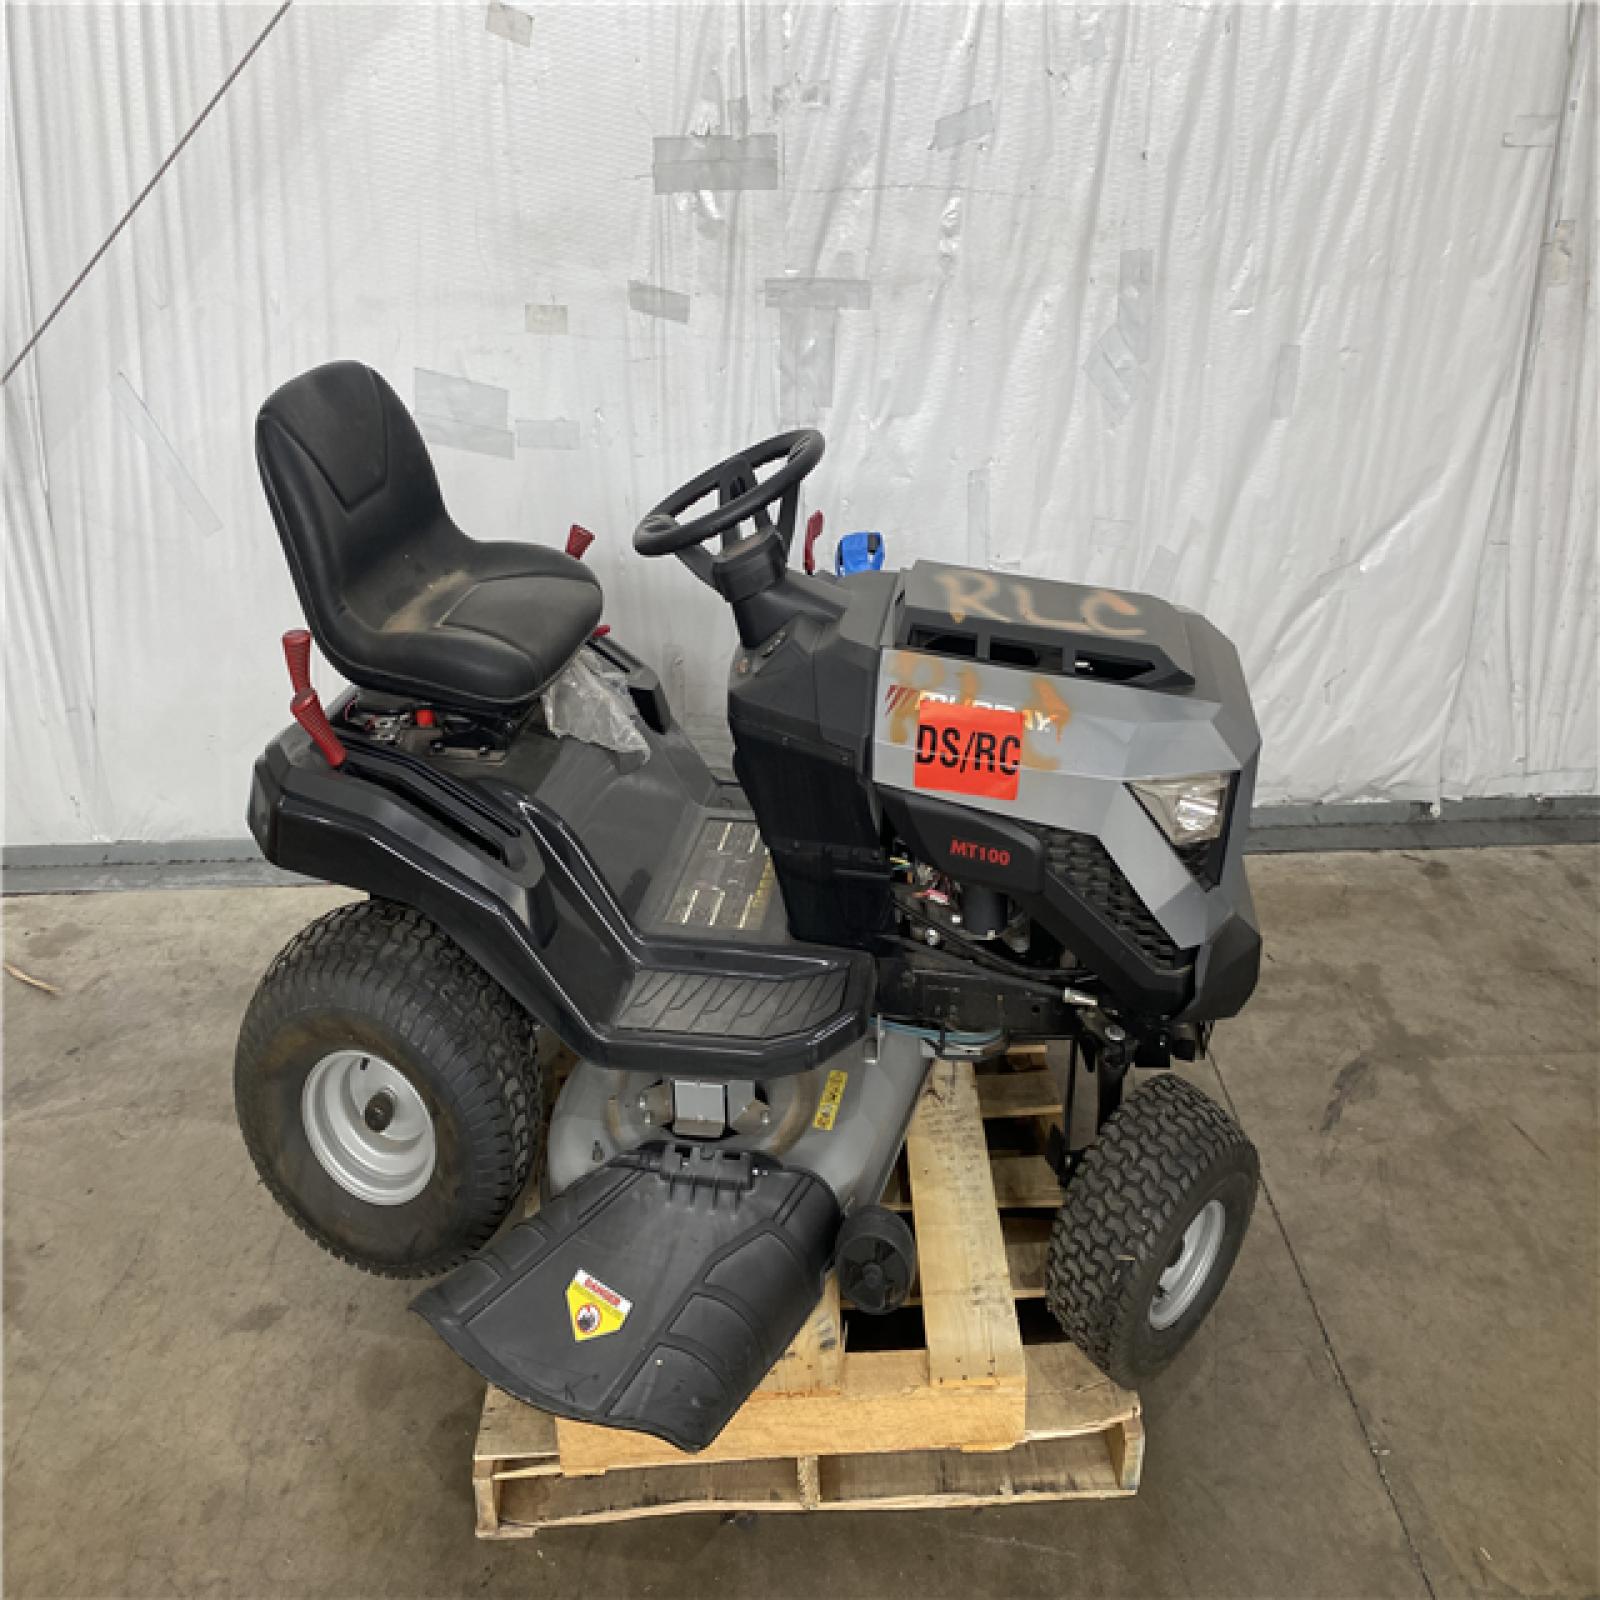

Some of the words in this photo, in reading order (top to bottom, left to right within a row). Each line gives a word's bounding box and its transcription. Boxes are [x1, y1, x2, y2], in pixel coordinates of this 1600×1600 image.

[935, 570, 1146, 637] RLC
[916, 724, 1020, 776] DS/RC
[950, 838, 1011, 866] MT100
